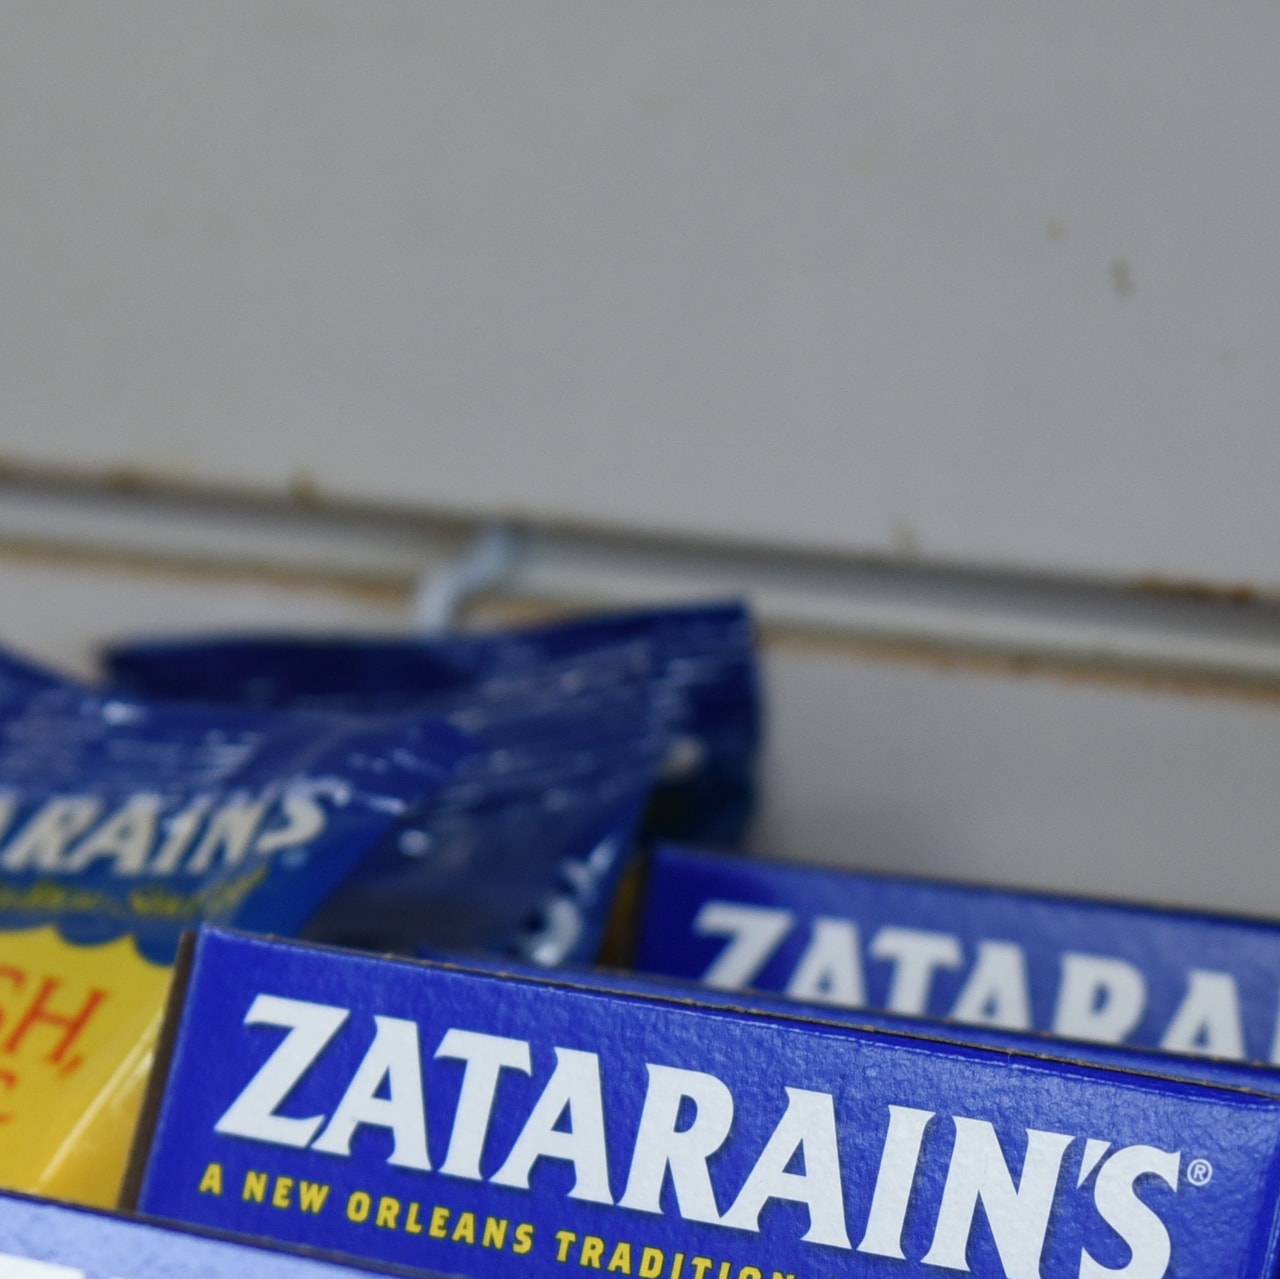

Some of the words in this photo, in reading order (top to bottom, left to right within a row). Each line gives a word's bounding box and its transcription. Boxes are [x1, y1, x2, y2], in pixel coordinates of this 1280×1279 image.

[199, 1162, 222, 1194] A
[243, 1172, 328, 1214] NEW
[346, 1192, 535, 1255] ORLEANS
